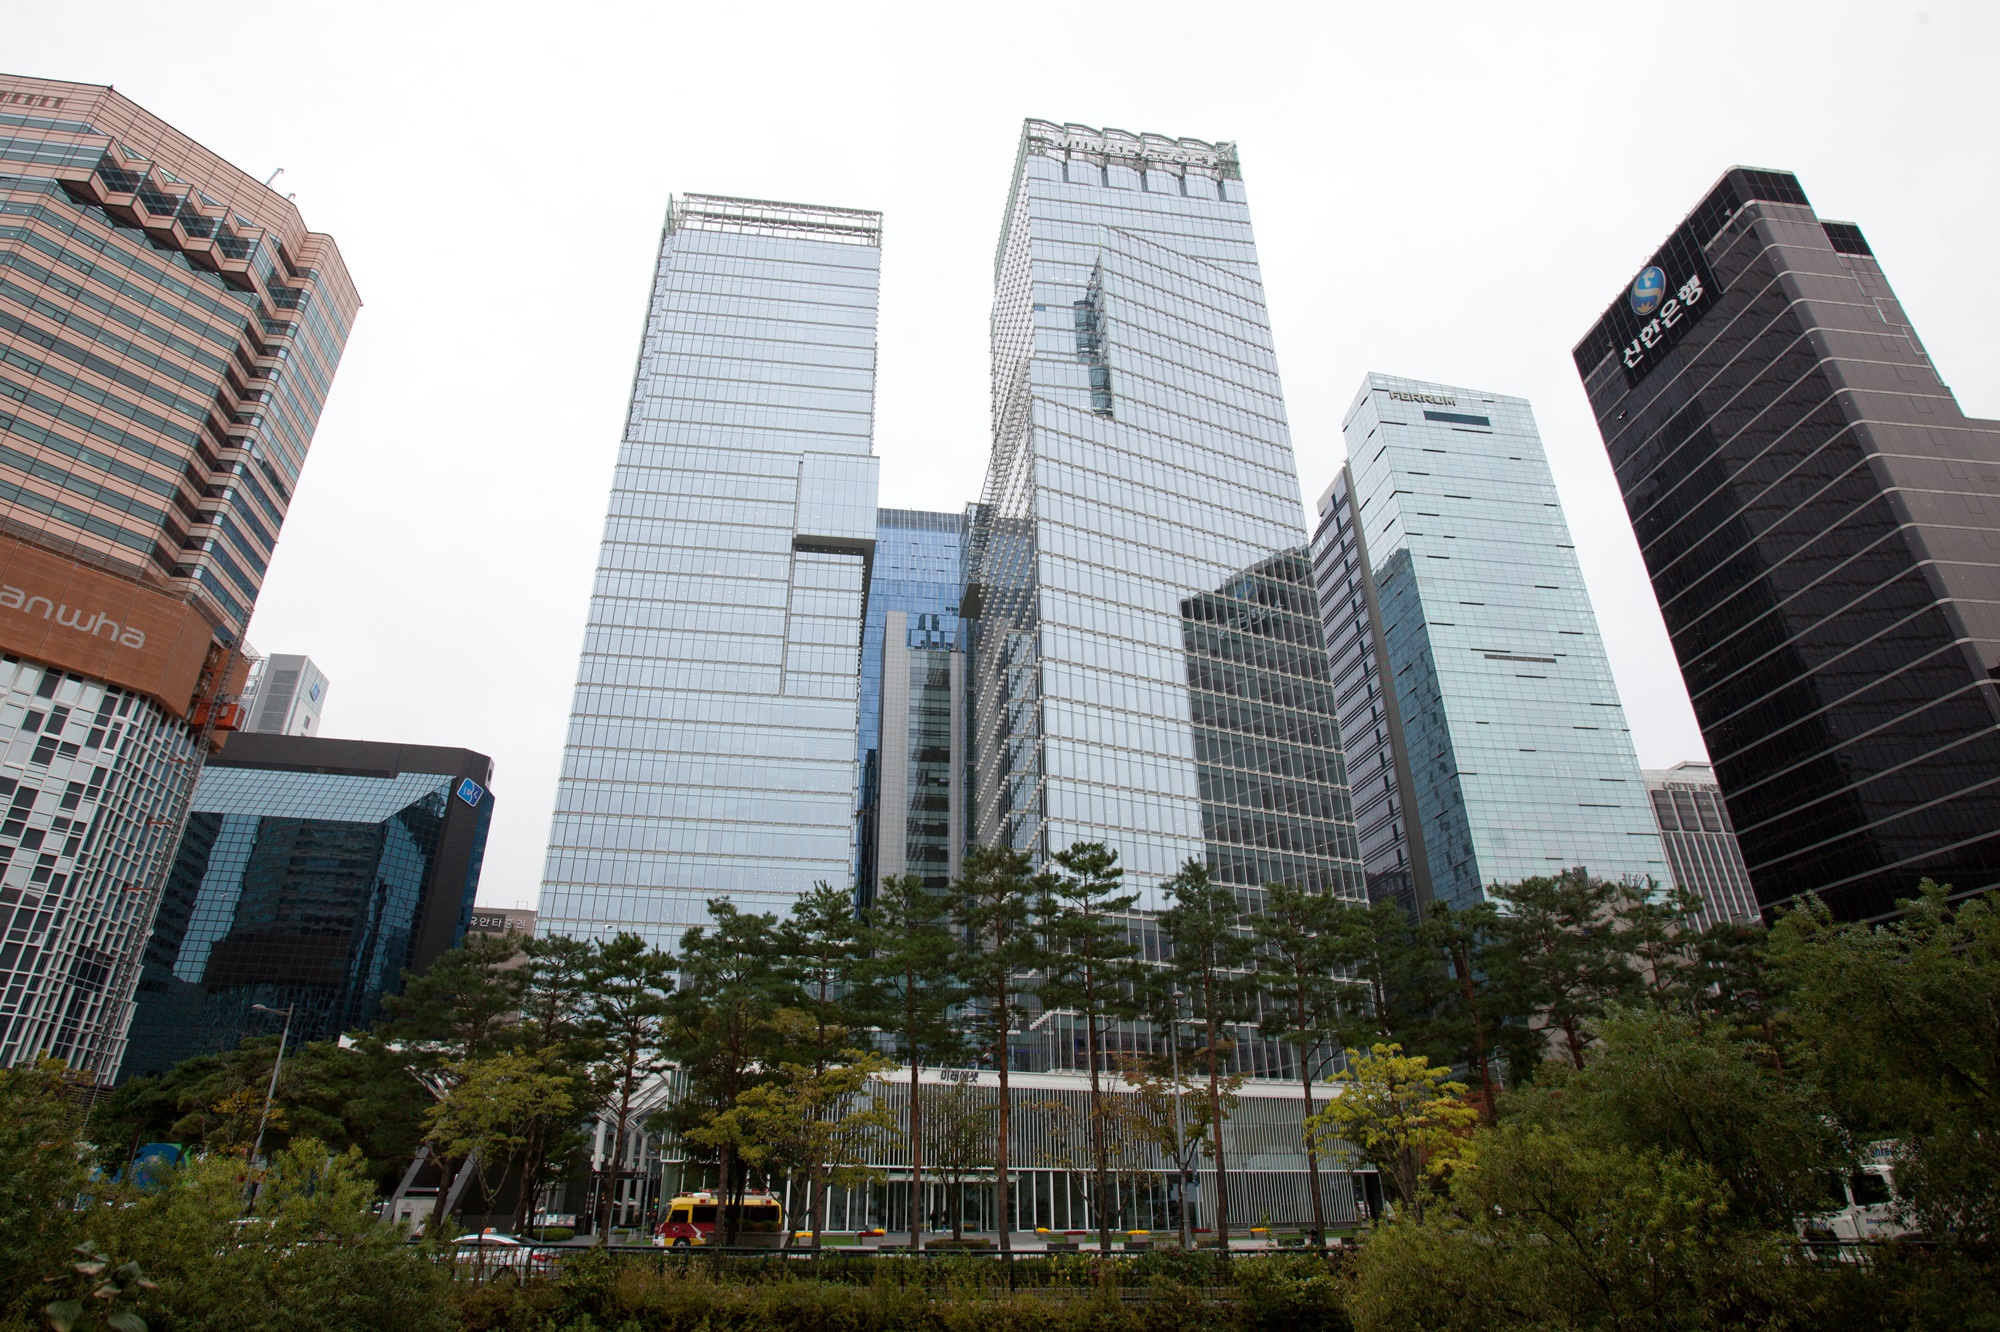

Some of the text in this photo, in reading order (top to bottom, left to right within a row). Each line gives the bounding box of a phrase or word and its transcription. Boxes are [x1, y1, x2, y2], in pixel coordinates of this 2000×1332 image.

[1052, 133, 1218, 166] MIRAE ASSET
[1623, 274, 1703, 369] 신한은행
[1389, 391, 1456, 407] FERRUM
[0, 584, 146, 650] anwha
[1662, 781, 1697, 791] LOTTE
[940, 1070, 979, 1083] 미래에셋
